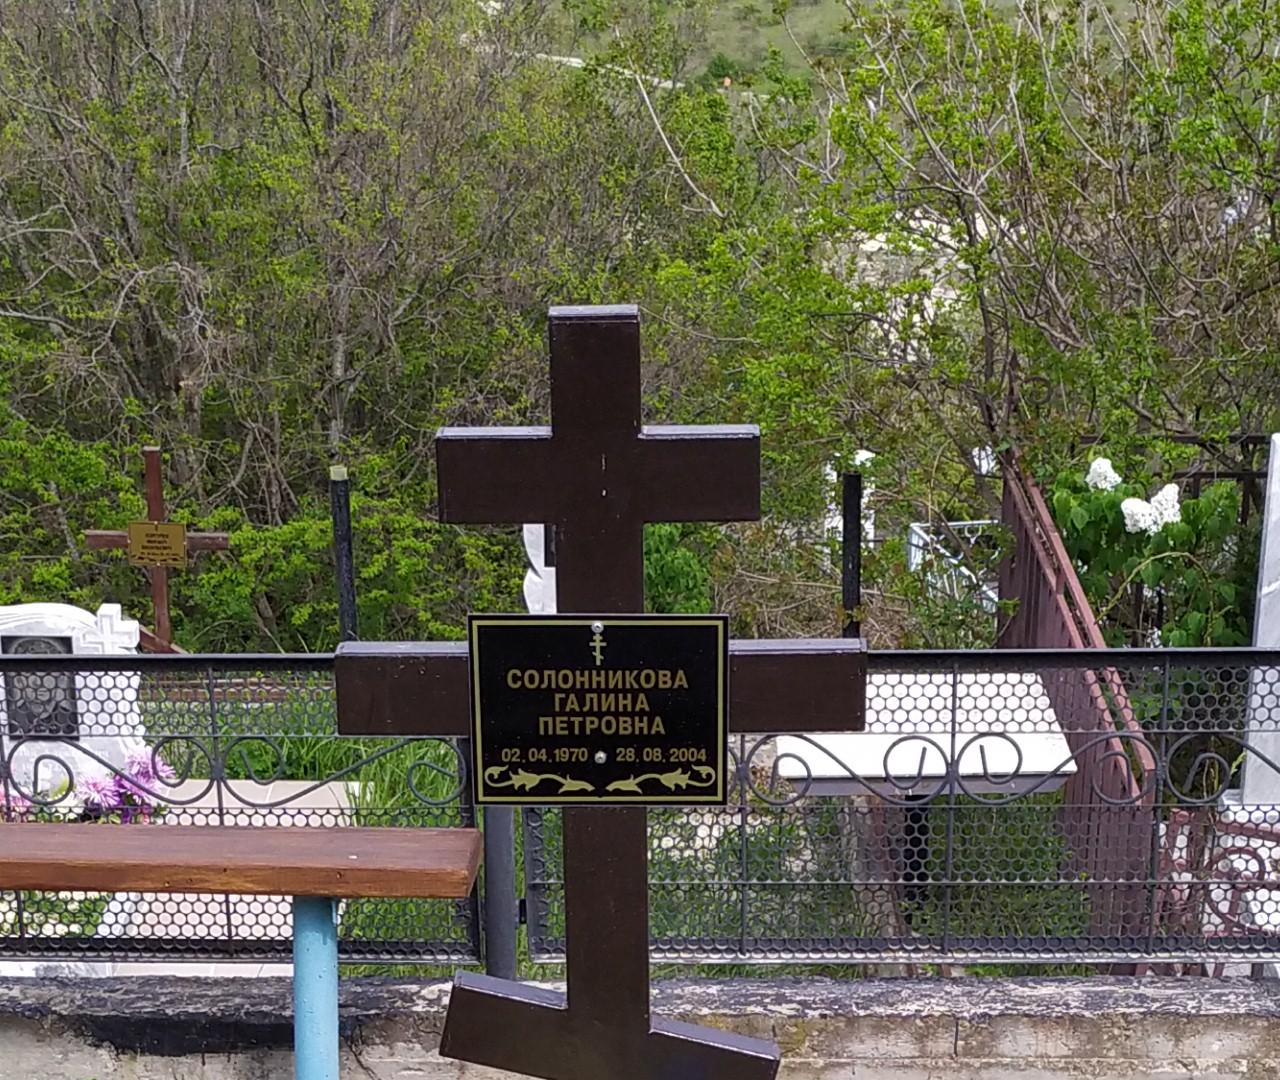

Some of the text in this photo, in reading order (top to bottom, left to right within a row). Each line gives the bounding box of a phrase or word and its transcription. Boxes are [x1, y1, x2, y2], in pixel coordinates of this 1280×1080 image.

[506, 669, 689, 690] СОЛОННИКОВА
[553, 692, 650, 713] ГАЛИНА
[538, 715, 666, 736] ПЕТРОВНА
